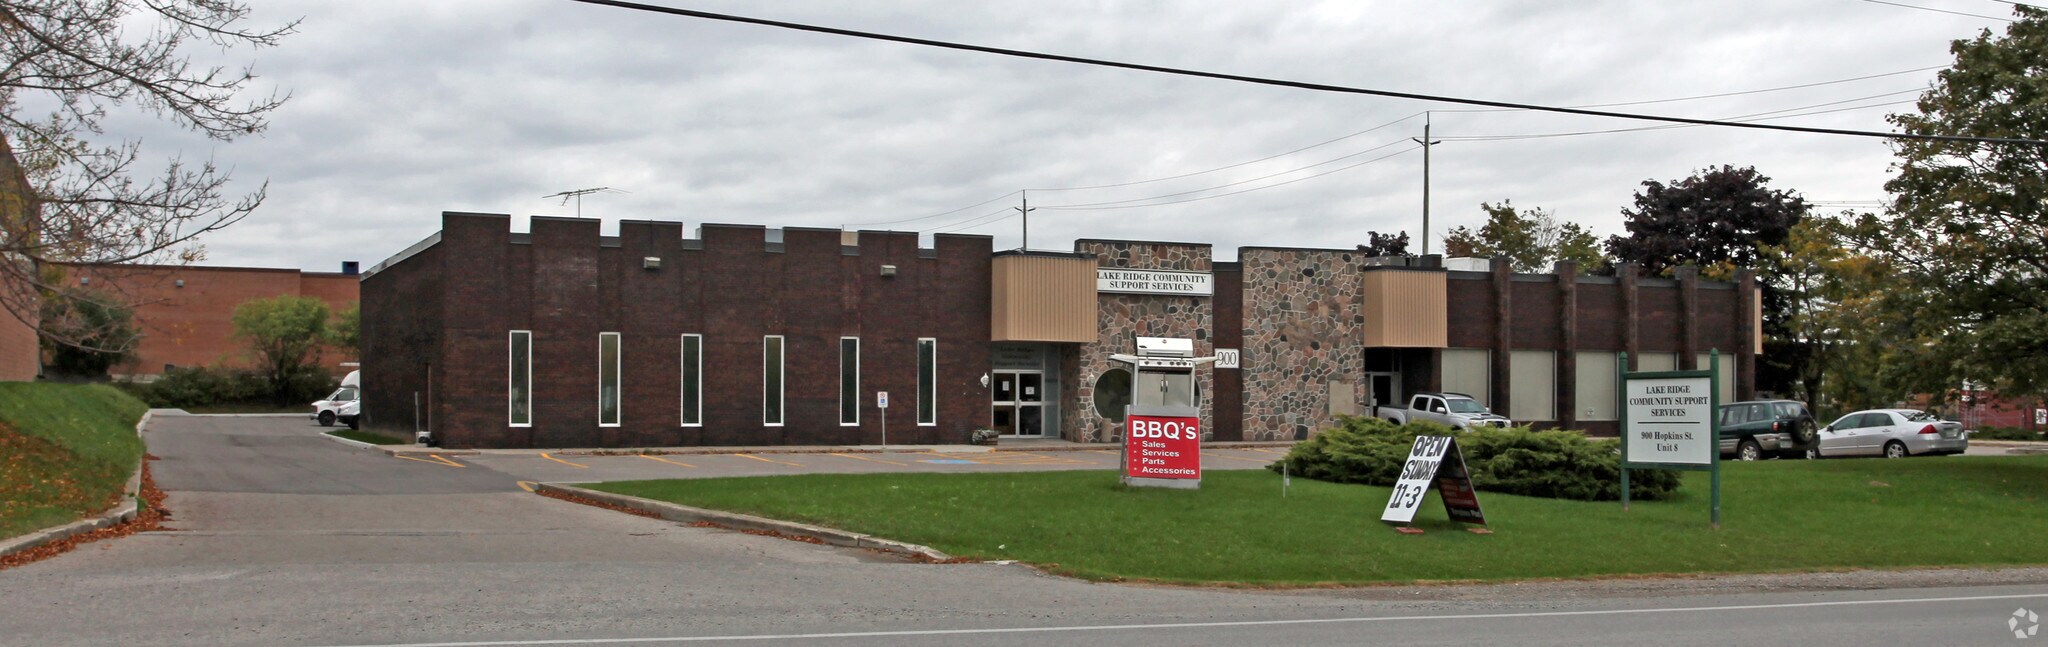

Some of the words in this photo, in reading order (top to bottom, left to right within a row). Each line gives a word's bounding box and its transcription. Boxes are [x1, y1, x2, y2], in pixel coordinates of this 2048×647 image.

[1097, 271, 1120, 280] LAKE
[1123, 272, 1150, 281] RIDGE
[1153, 273, 1206, 283] COMMUNITY
[1110, 280, 1149, 290] SUPPORT
[1152, 281, 1194, 291] SERVICES
[1217, 351, 1237, 366] 900
[1646, 386, 1665, 394] LAKE
[1667, 385, 1690, 394] RIDGE
[1629, 397, 1673, 405] COMMUNITY
[1675, 397, 1708, 405] SUPPORT
[1651, 408, 1686, 417] SERVICES
[1132, 420, 1197, 440] BBQ's
[1641, 431, 1653, 440] 900
[1654, 431, 1683, 441] Hopkins
[1684, 432, 1694, 440] St.
[1142, 440, 1166, 448] Sales
[1413, 436, 1446, 457] OPEN
[1656, 443, 1673, 452] Unit
[1142, 449, 1180, 457] Services
[1141, 466, 1196, 475] Accessories
[1389, 483, 1422, 509] 11-3
